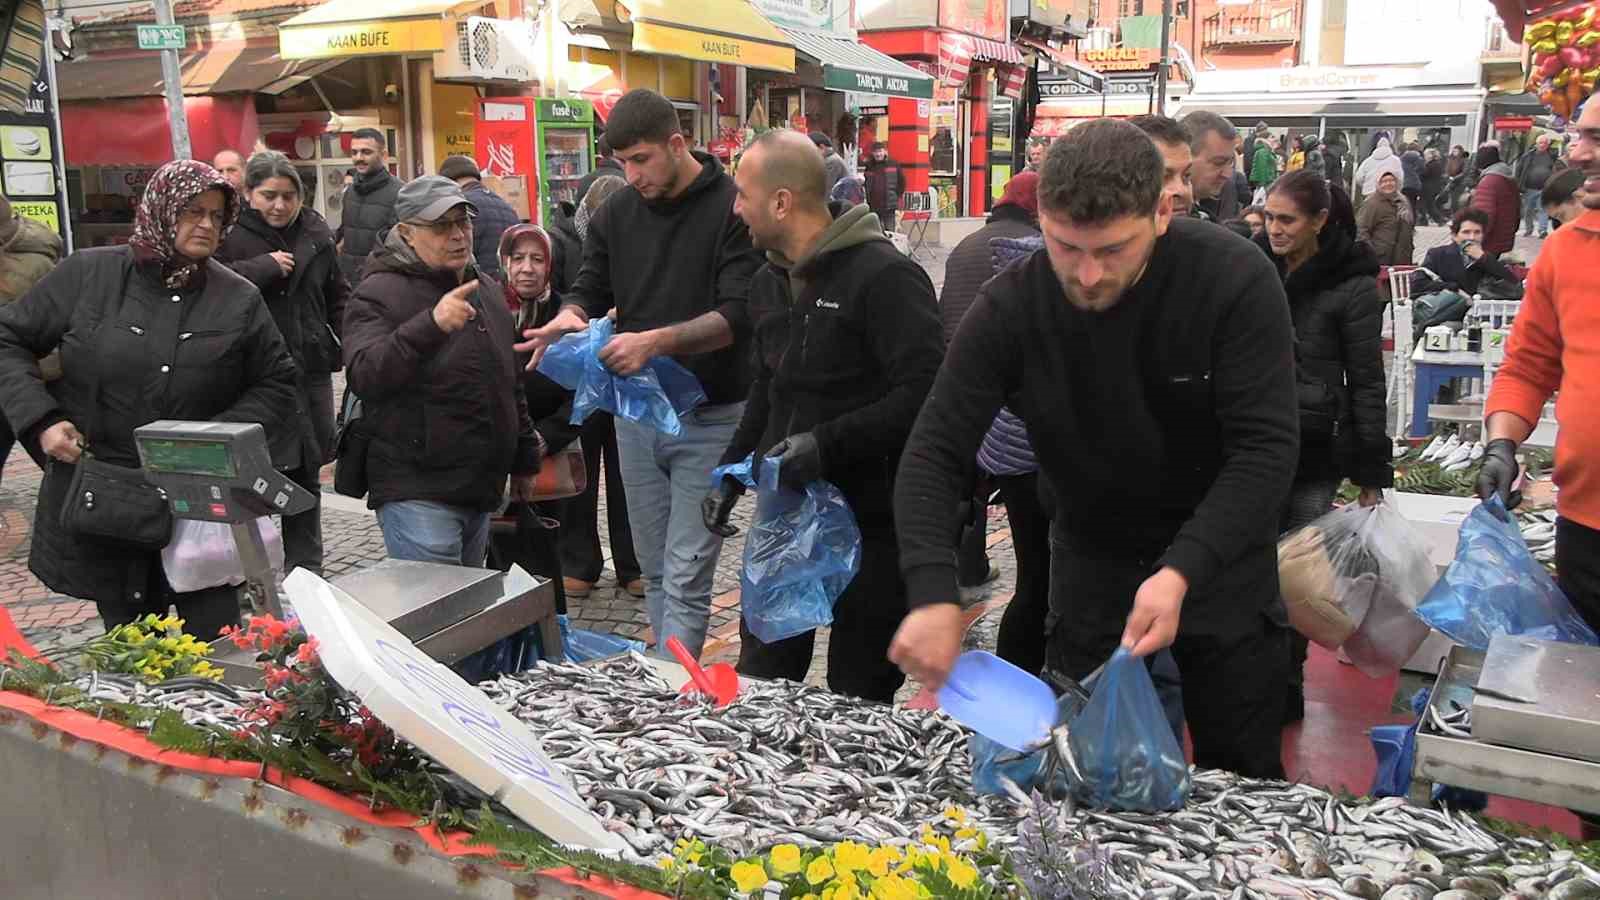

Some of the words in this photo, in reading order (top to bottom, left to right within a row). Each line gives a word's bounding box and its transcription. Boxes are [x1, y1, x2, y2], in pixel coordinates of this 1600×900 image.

[160, 29, 182, 40] WC
[328, 34, 358, 48] KAAN
[702, 41, 721, 55] KAAN
[856, 73, 884, 91] TARÇIN
[886, 78, 909, 92] AKTAR
[1431, 335, 1441, 348] 2
